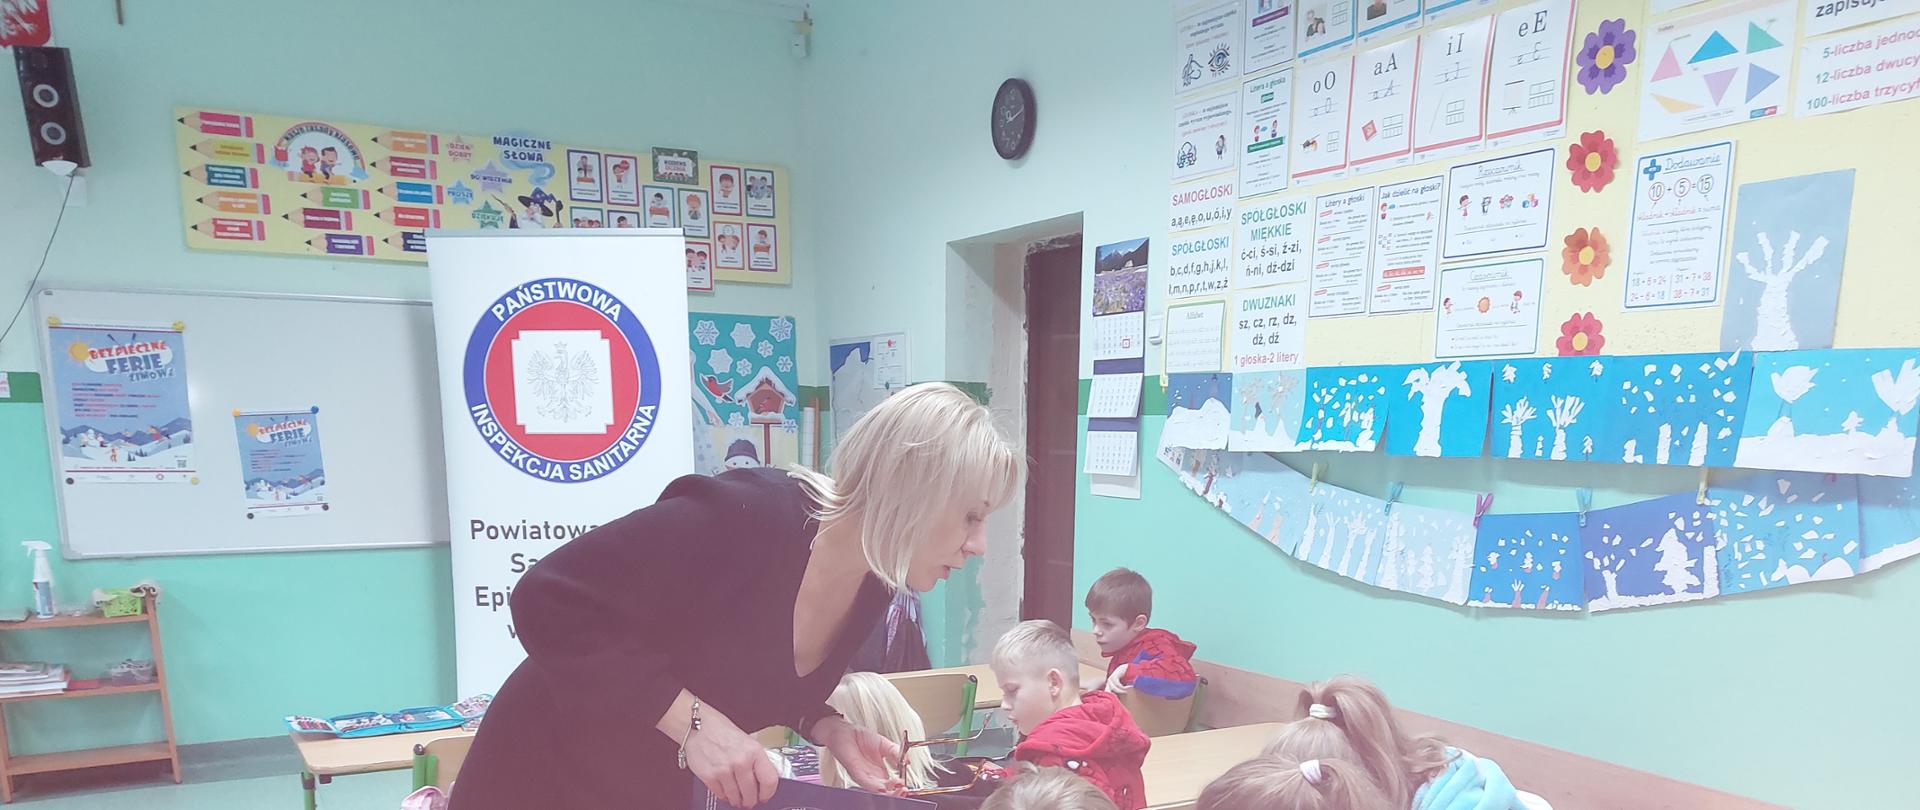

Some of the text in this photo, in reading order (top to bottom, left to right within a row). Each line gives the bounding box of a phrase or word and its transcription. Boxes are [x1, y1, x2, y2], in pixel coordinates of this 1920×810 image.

[1823, 40, 1872, 58] 5-liczba
[1816, 65, 1871, 84] 12-liczba
[1807, 90, 1870, 110] 100-liczba
[493, 136, 552, 150] MAGICZNE
[503, 150, 544, 162] SŁOWA
[1172, 184, 1233, 207] SAMOGŁOSKI
[1241, 201, 1307, 226] SPÓŁGŁOSKI
[1250, 222, 1292, 242] MIĘKKIE
[1172, 236, 1229, 257] SPÓŁGŁOSKI
[491, 281, 622, 322] PAŃSTWOWA
[1242, 294, 1296, 312] DWUZNAKI
[1238, 312, 1297, 330] sz, cz, rz, dz,
[89, 340, 168, 360] BEZPIECZNE
[1276, 351, 1299, 365] litery
[105, 353, 163, 374] FERIE
[270, 428, 305, 443] FERIE
[471, 403, 656, 481] INSPEKCJA SANITARNA
[470, 519, 600, 540] Powiatow
